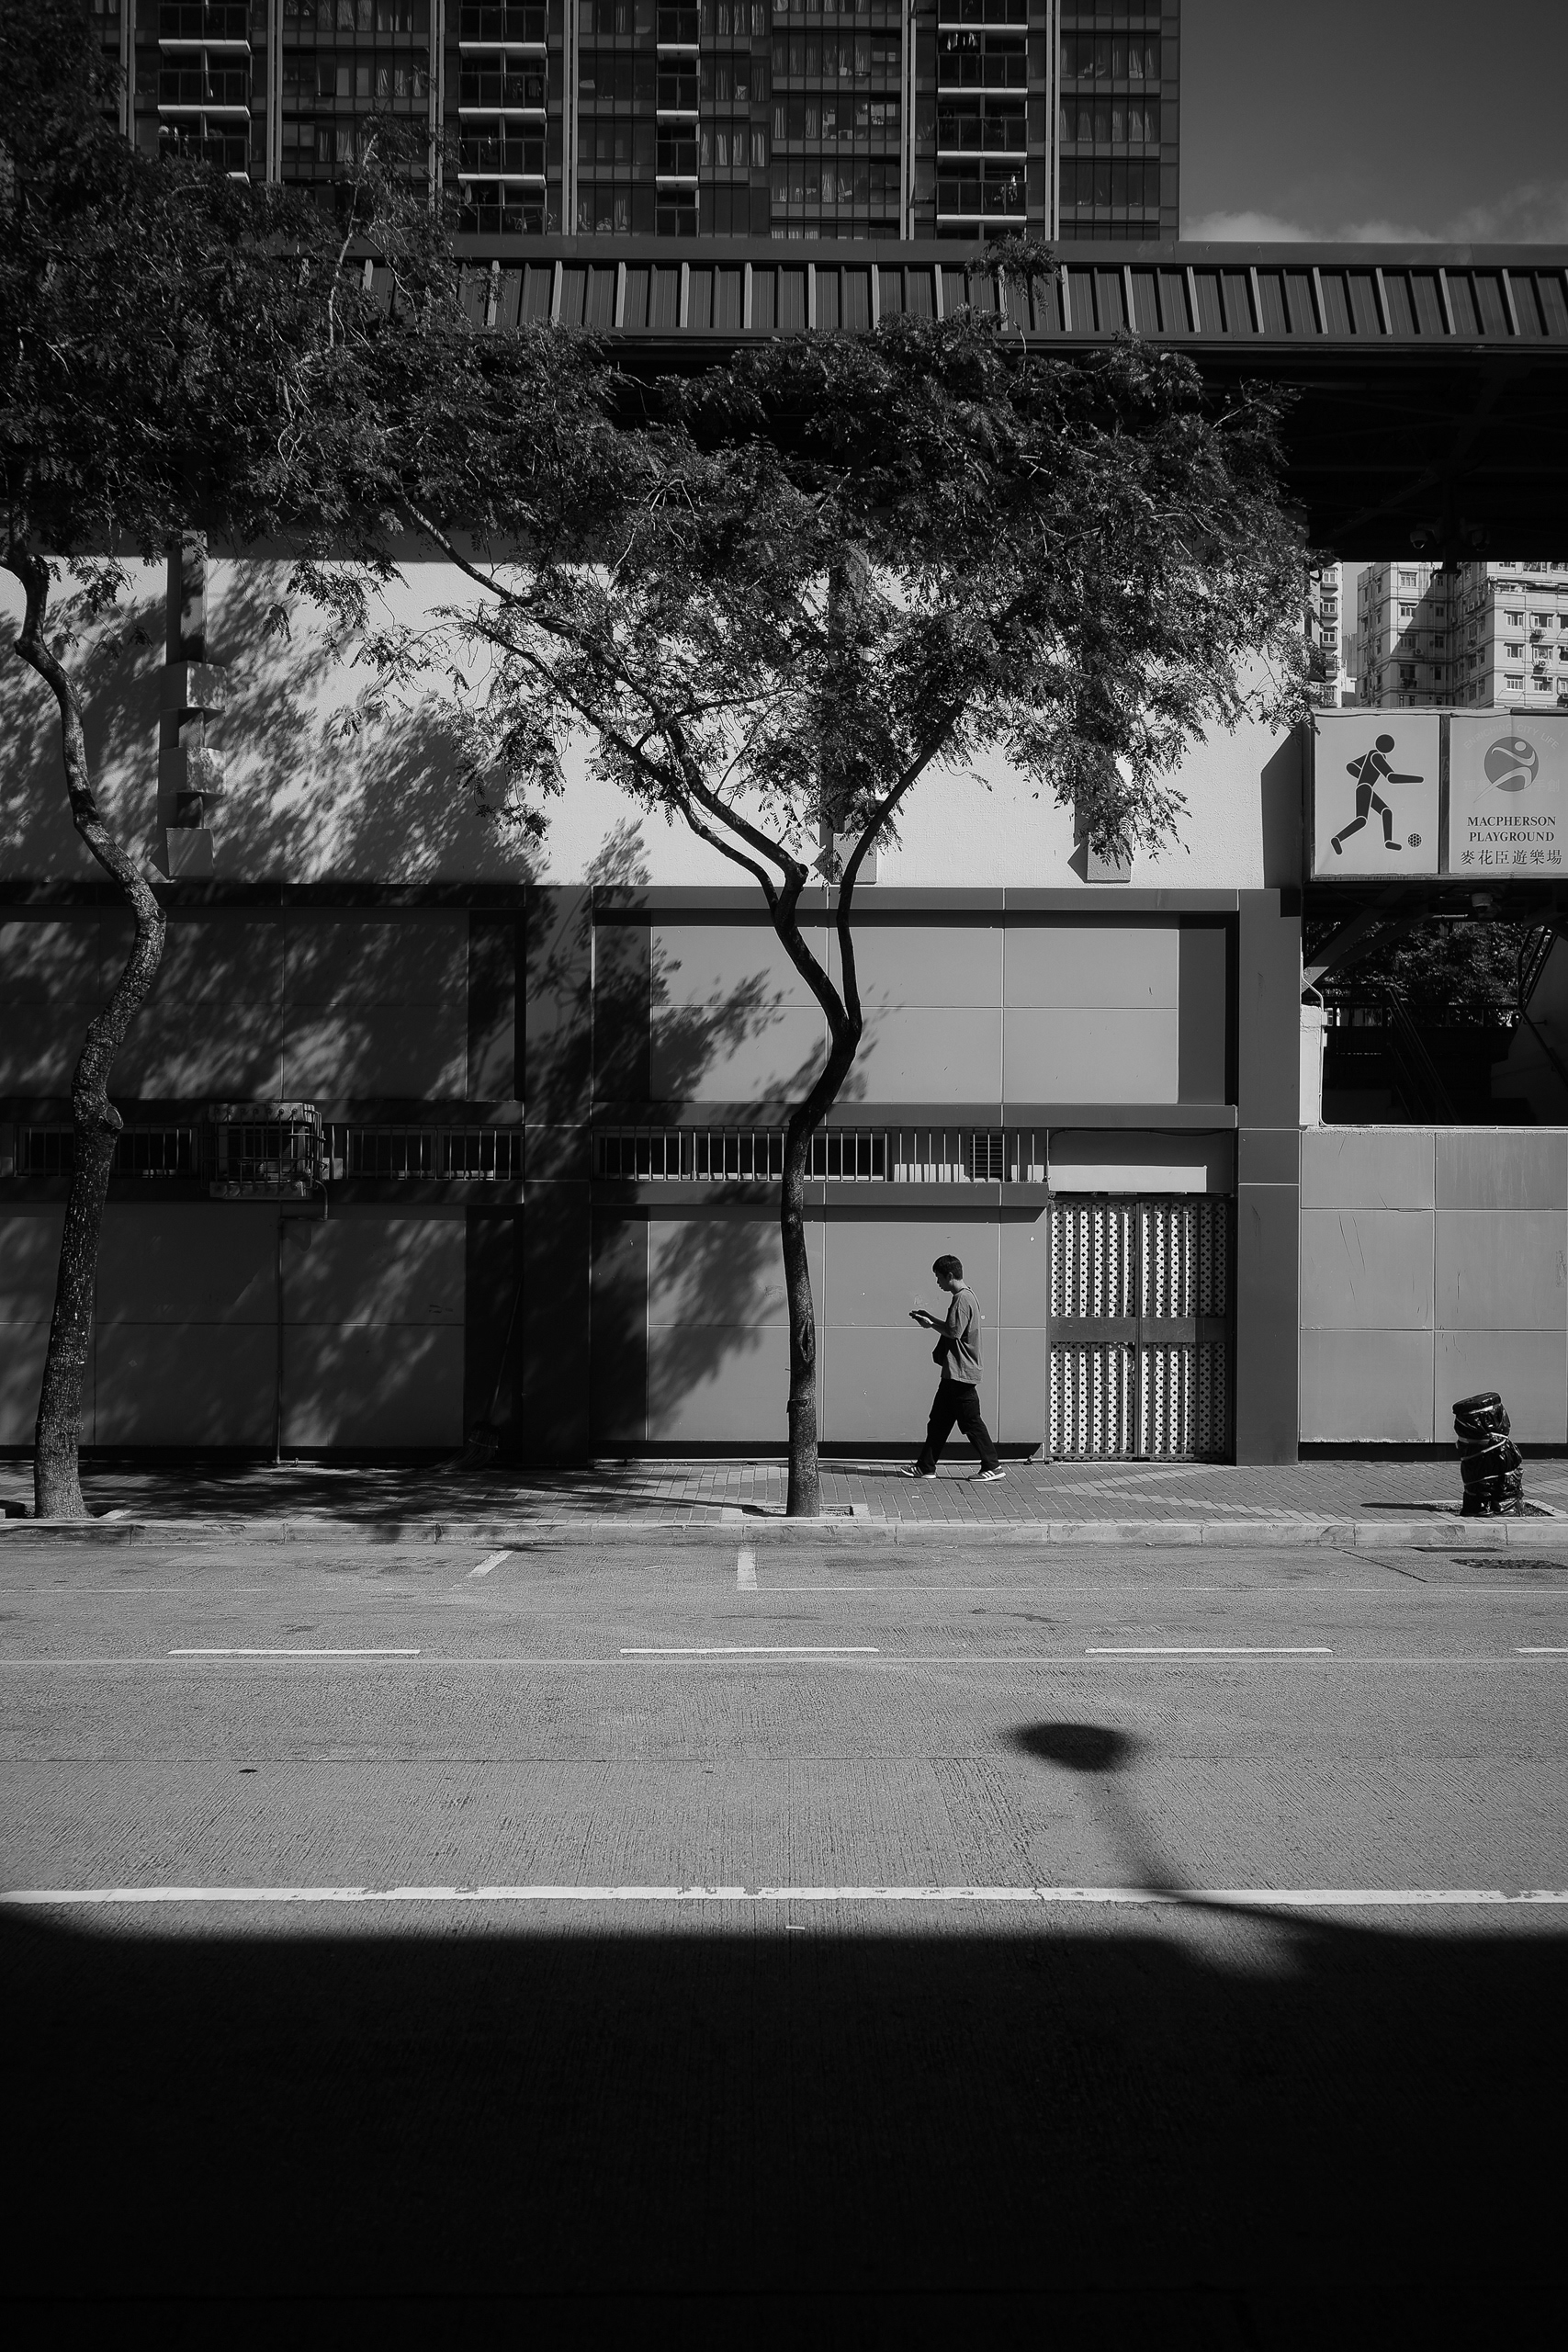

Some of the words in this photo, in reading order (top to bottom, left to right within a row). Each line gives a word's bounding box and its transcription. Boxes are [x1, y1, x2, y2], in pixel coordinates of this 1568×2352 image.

[1463, 723, 1512, 750] ENRICHING
[1517, 724, 1539, 736] CITY
[1540, 732, 1559, 750] LIFE
[1467, 816, 1556, 827] MACPHERSON
[1469, 831, 1555, 842] PLAYGROUND
[1461, 849, 1562, 865] 麥花臣遊樂場
